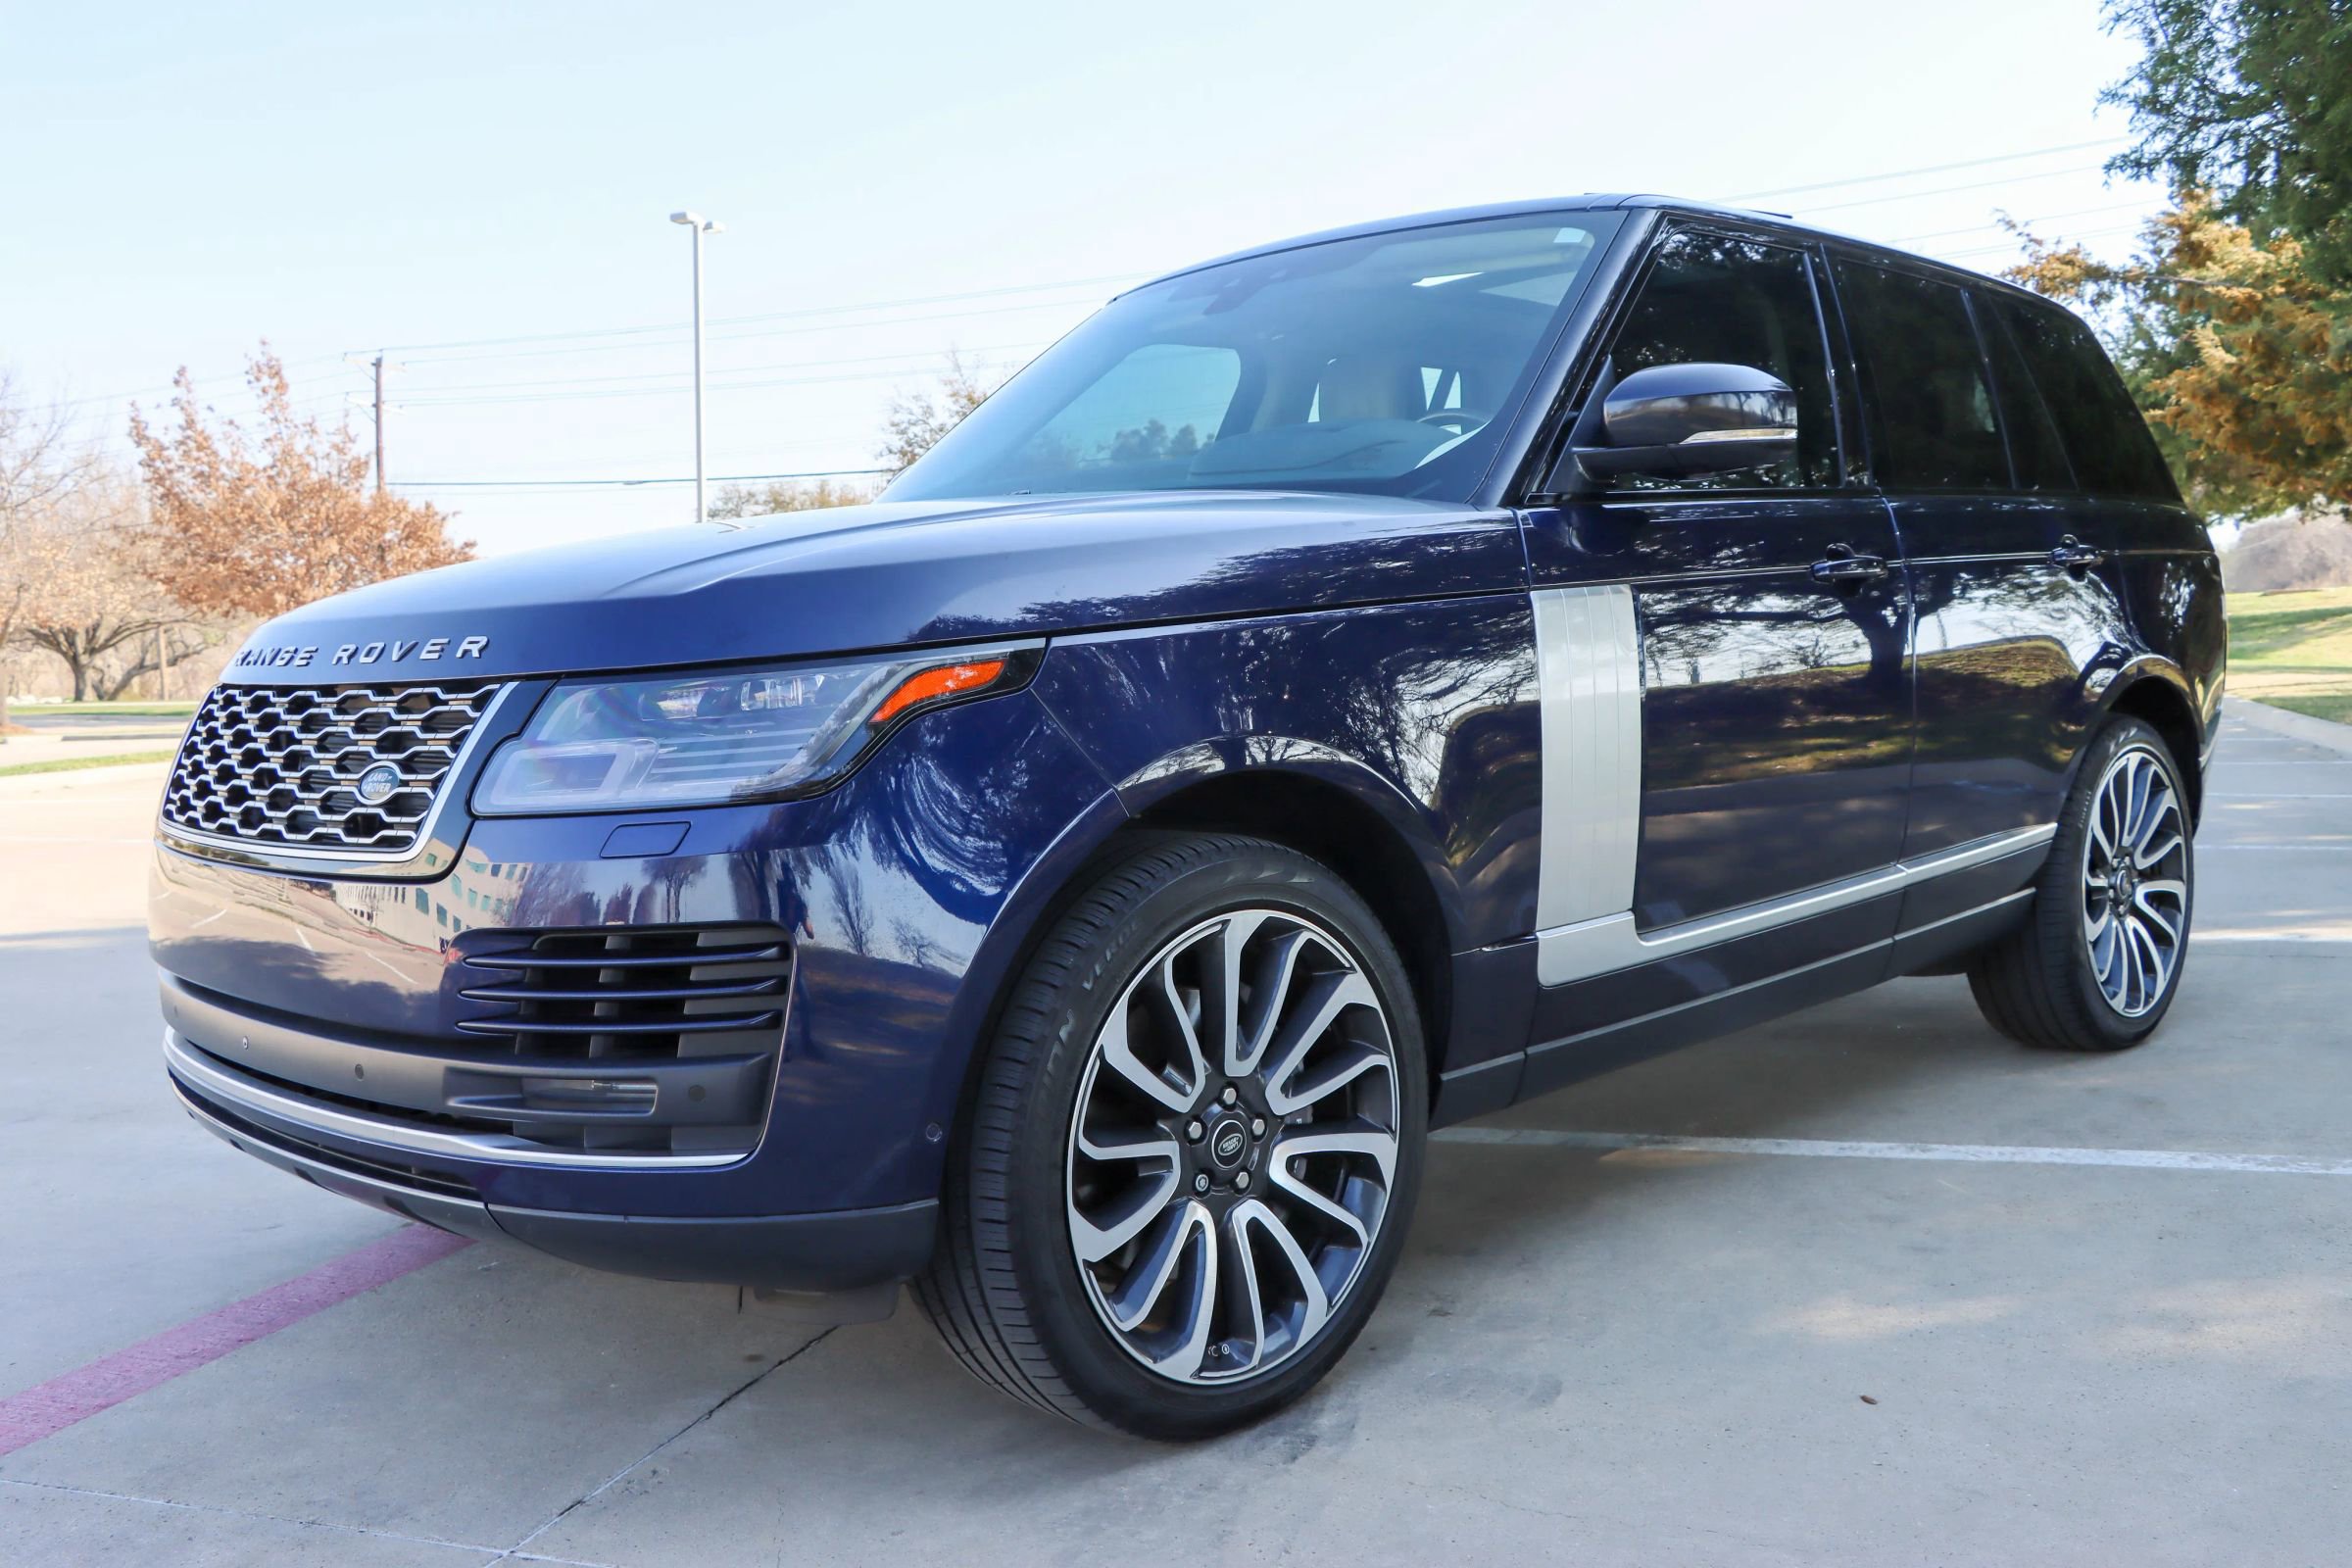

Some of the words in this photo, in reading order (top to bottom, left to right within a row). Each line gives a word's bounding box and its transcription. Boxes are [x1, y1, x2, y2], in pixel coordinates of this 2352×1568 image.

[234, 645, 318, 667] RANGE
[332, 635, 490, 665] ROVER
[367, 772, 389, 782] LAND
[365, 782, 392, 793] ROVER
